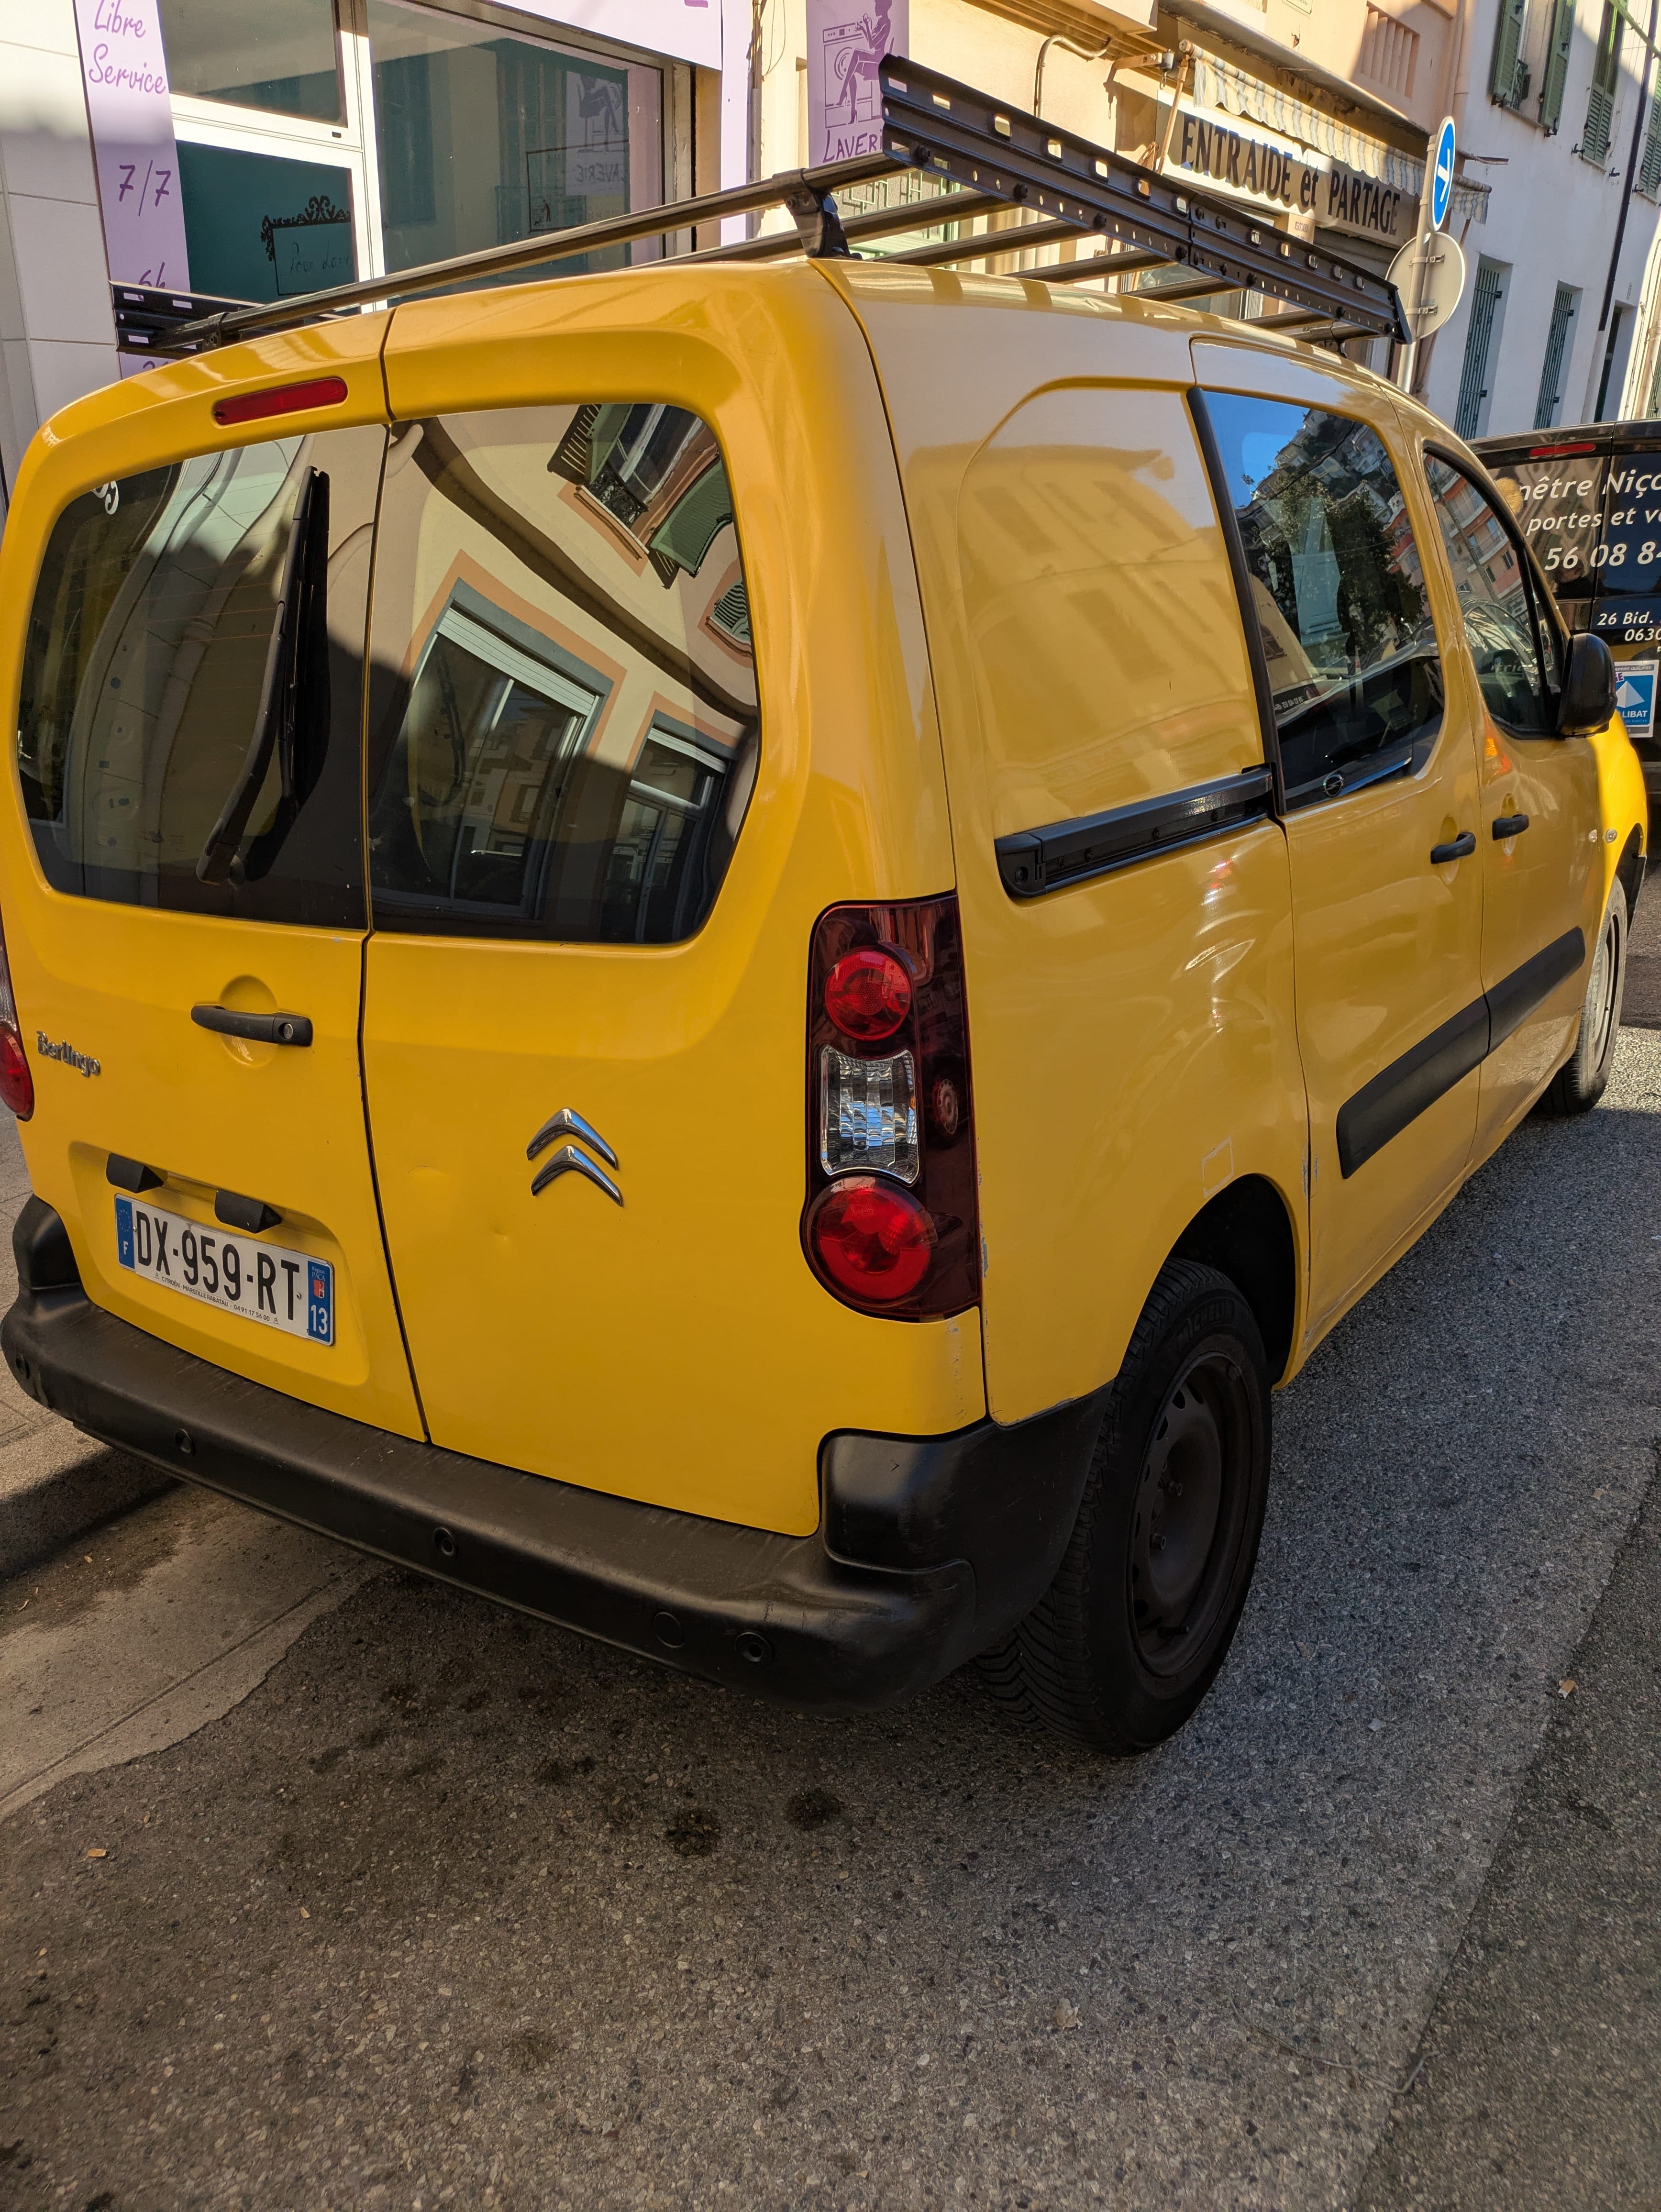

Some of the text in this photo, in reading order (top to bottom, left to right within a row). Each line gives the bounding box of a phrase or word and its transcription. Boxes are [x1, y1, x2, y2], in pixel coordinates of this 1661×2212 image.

[94, 0, 146, 38] Libre
[89, 44, 166, 94] Service
[119, 160, 171, 217] 7/7
[1181, 115, 1400, 236] ENTRAIDE et PARTAGE
[1520, 476, 1593, 501] nêtre
[1526, 512, 1603, 536] portes
[1611, 508, 1637, 525] et
[1544, 546, 1579, 571] 56
[1590, 543, 1627, 568] 08
[1597, 613, 1617, 626] 26
[1621, 710, 1648, 718] LIBAT
[36, 1030, 101, 1078] Berlingo
[123, 1241, 129, 1255] F
[136, 1210, 300, 1321] DX-959-RT
[312, 1265, 325, 1275] Région
[312, 1272, 326, 1282] PACA
[183, 1285, 207, 1299] MARSEILLE
[207, 1294, 229, 1307] RABATAU
[311, 1304, 328, 1335] 13
